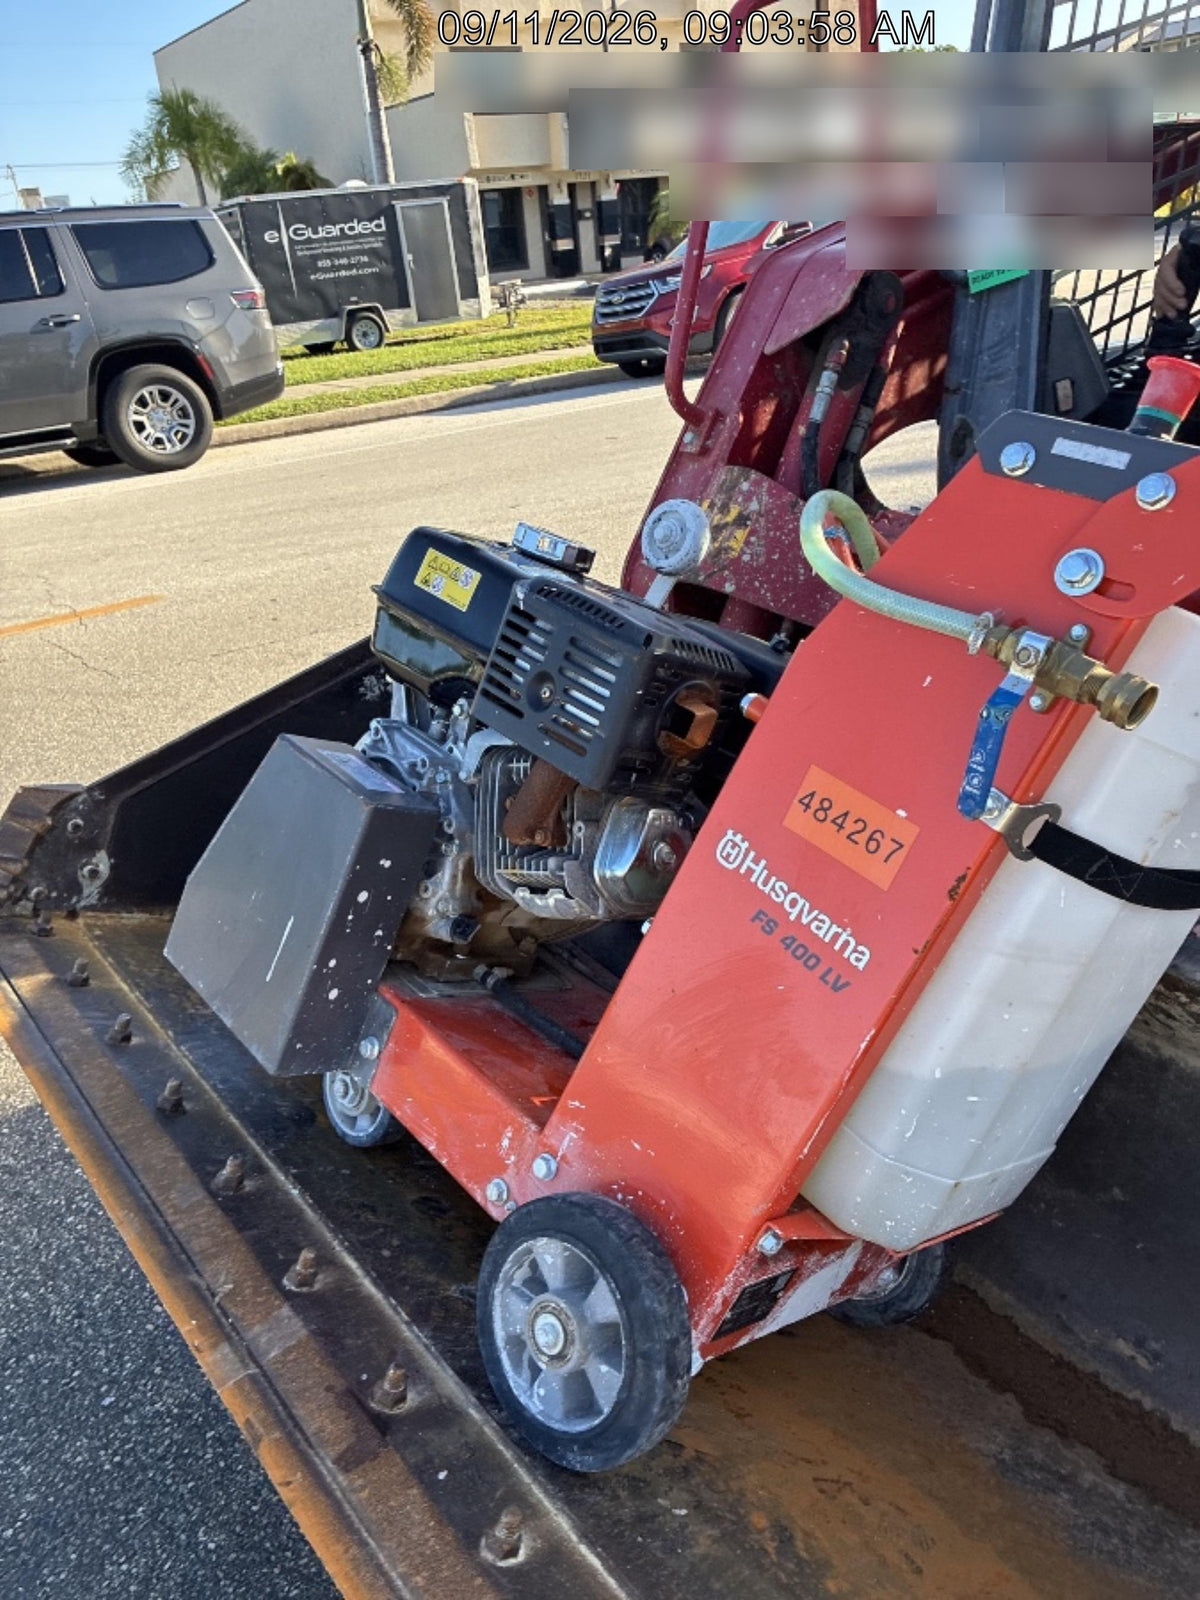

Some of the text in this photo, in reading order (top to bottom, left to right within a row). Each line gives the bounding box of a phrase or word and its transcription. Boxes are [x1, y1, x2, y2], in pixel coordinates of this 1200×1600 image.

[798, 789, 905, 864] 484267
[739, 850, 871, 972] Husqvarna
[751, 908, 852, 993] FS 400 LV
